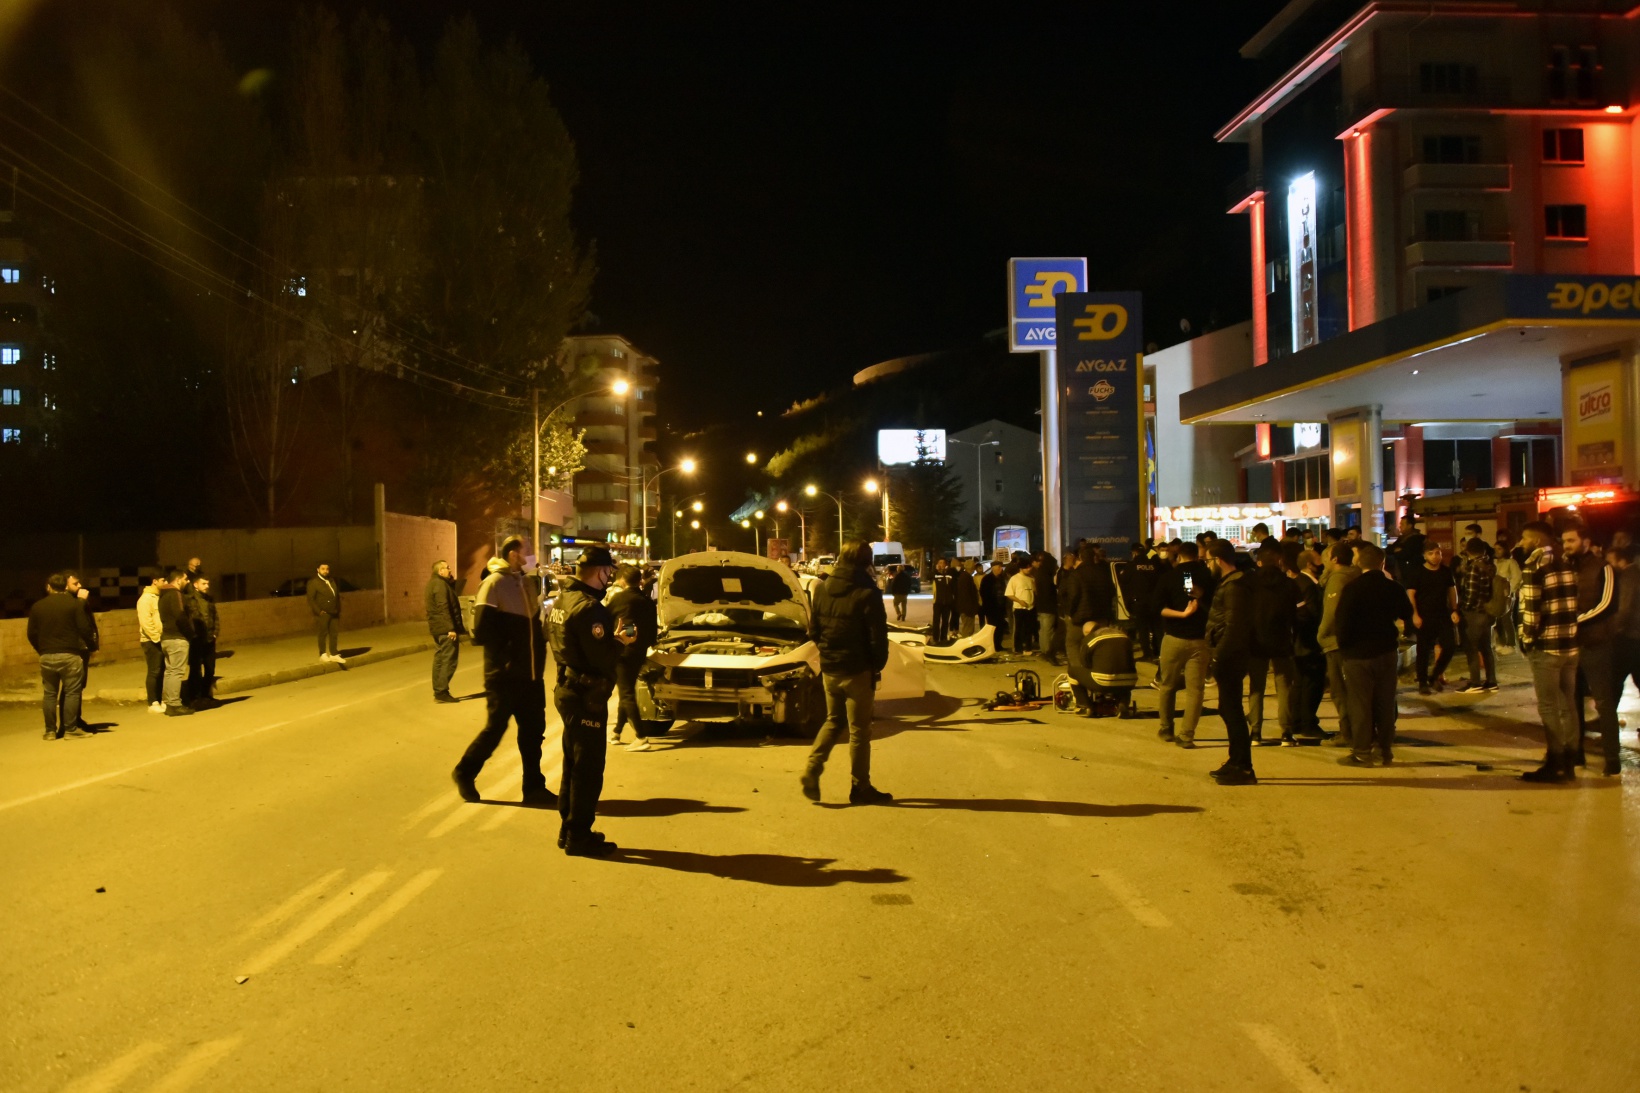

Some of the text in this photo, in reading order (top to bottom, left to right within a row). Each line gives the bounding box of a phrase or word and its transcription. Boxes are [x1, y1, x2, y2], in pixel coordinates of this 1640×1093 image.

[1024, 327, 1056, 340] AYG
[1075, 359, 1127, 372] AYGAZ
[1089, 386, 1114, 395] FUCHS
[1580, 392, 1611, 416] ultra
[1086, 536, 1130, 544] enimahalle
[580, 718, 601, 728] POLIS
